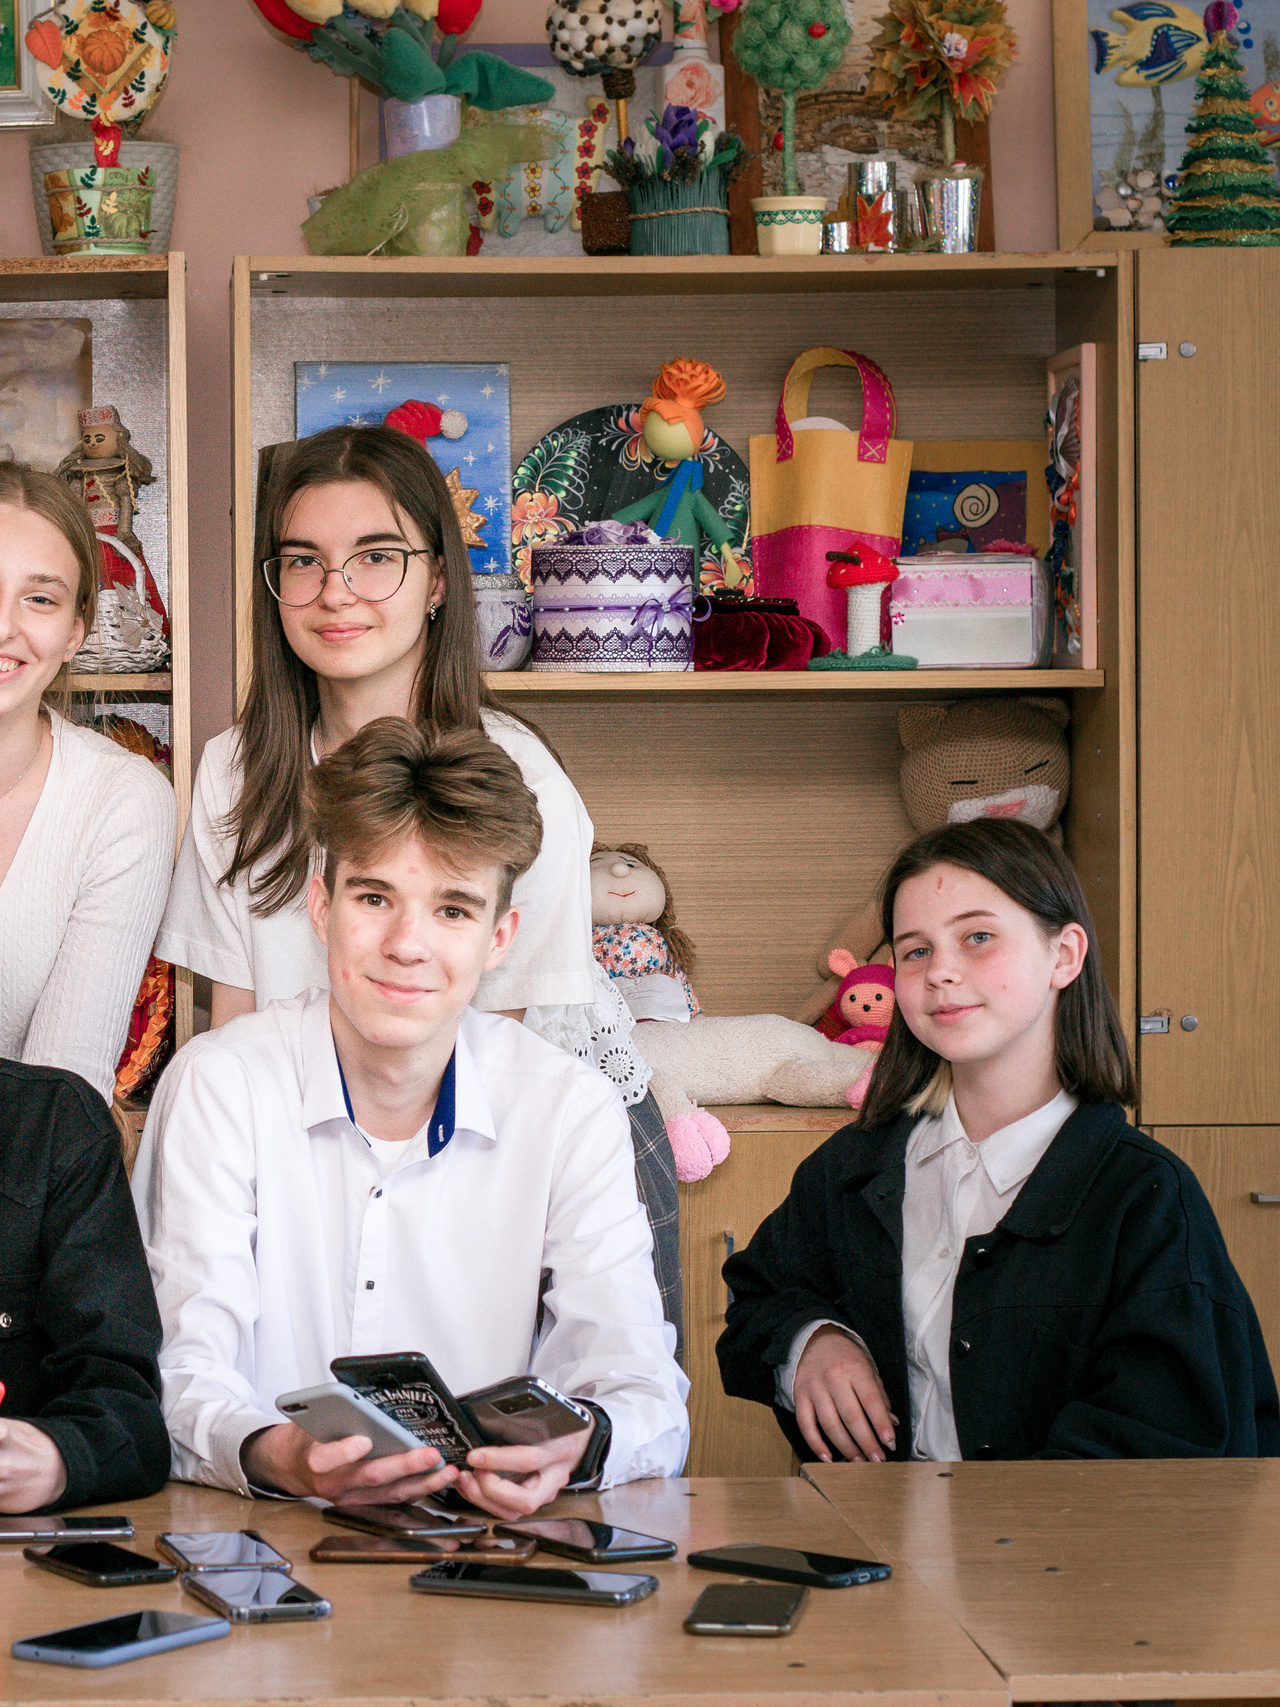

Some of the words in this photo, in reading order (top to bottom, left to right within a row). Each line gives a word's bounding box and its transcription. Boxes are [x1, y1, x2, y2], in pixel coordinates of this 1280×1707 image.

[365, 1391, 389, 1405] ACK
[410, 1427, 449, 1437] nessee
[422, 1437, 456, 1447] SKEY
